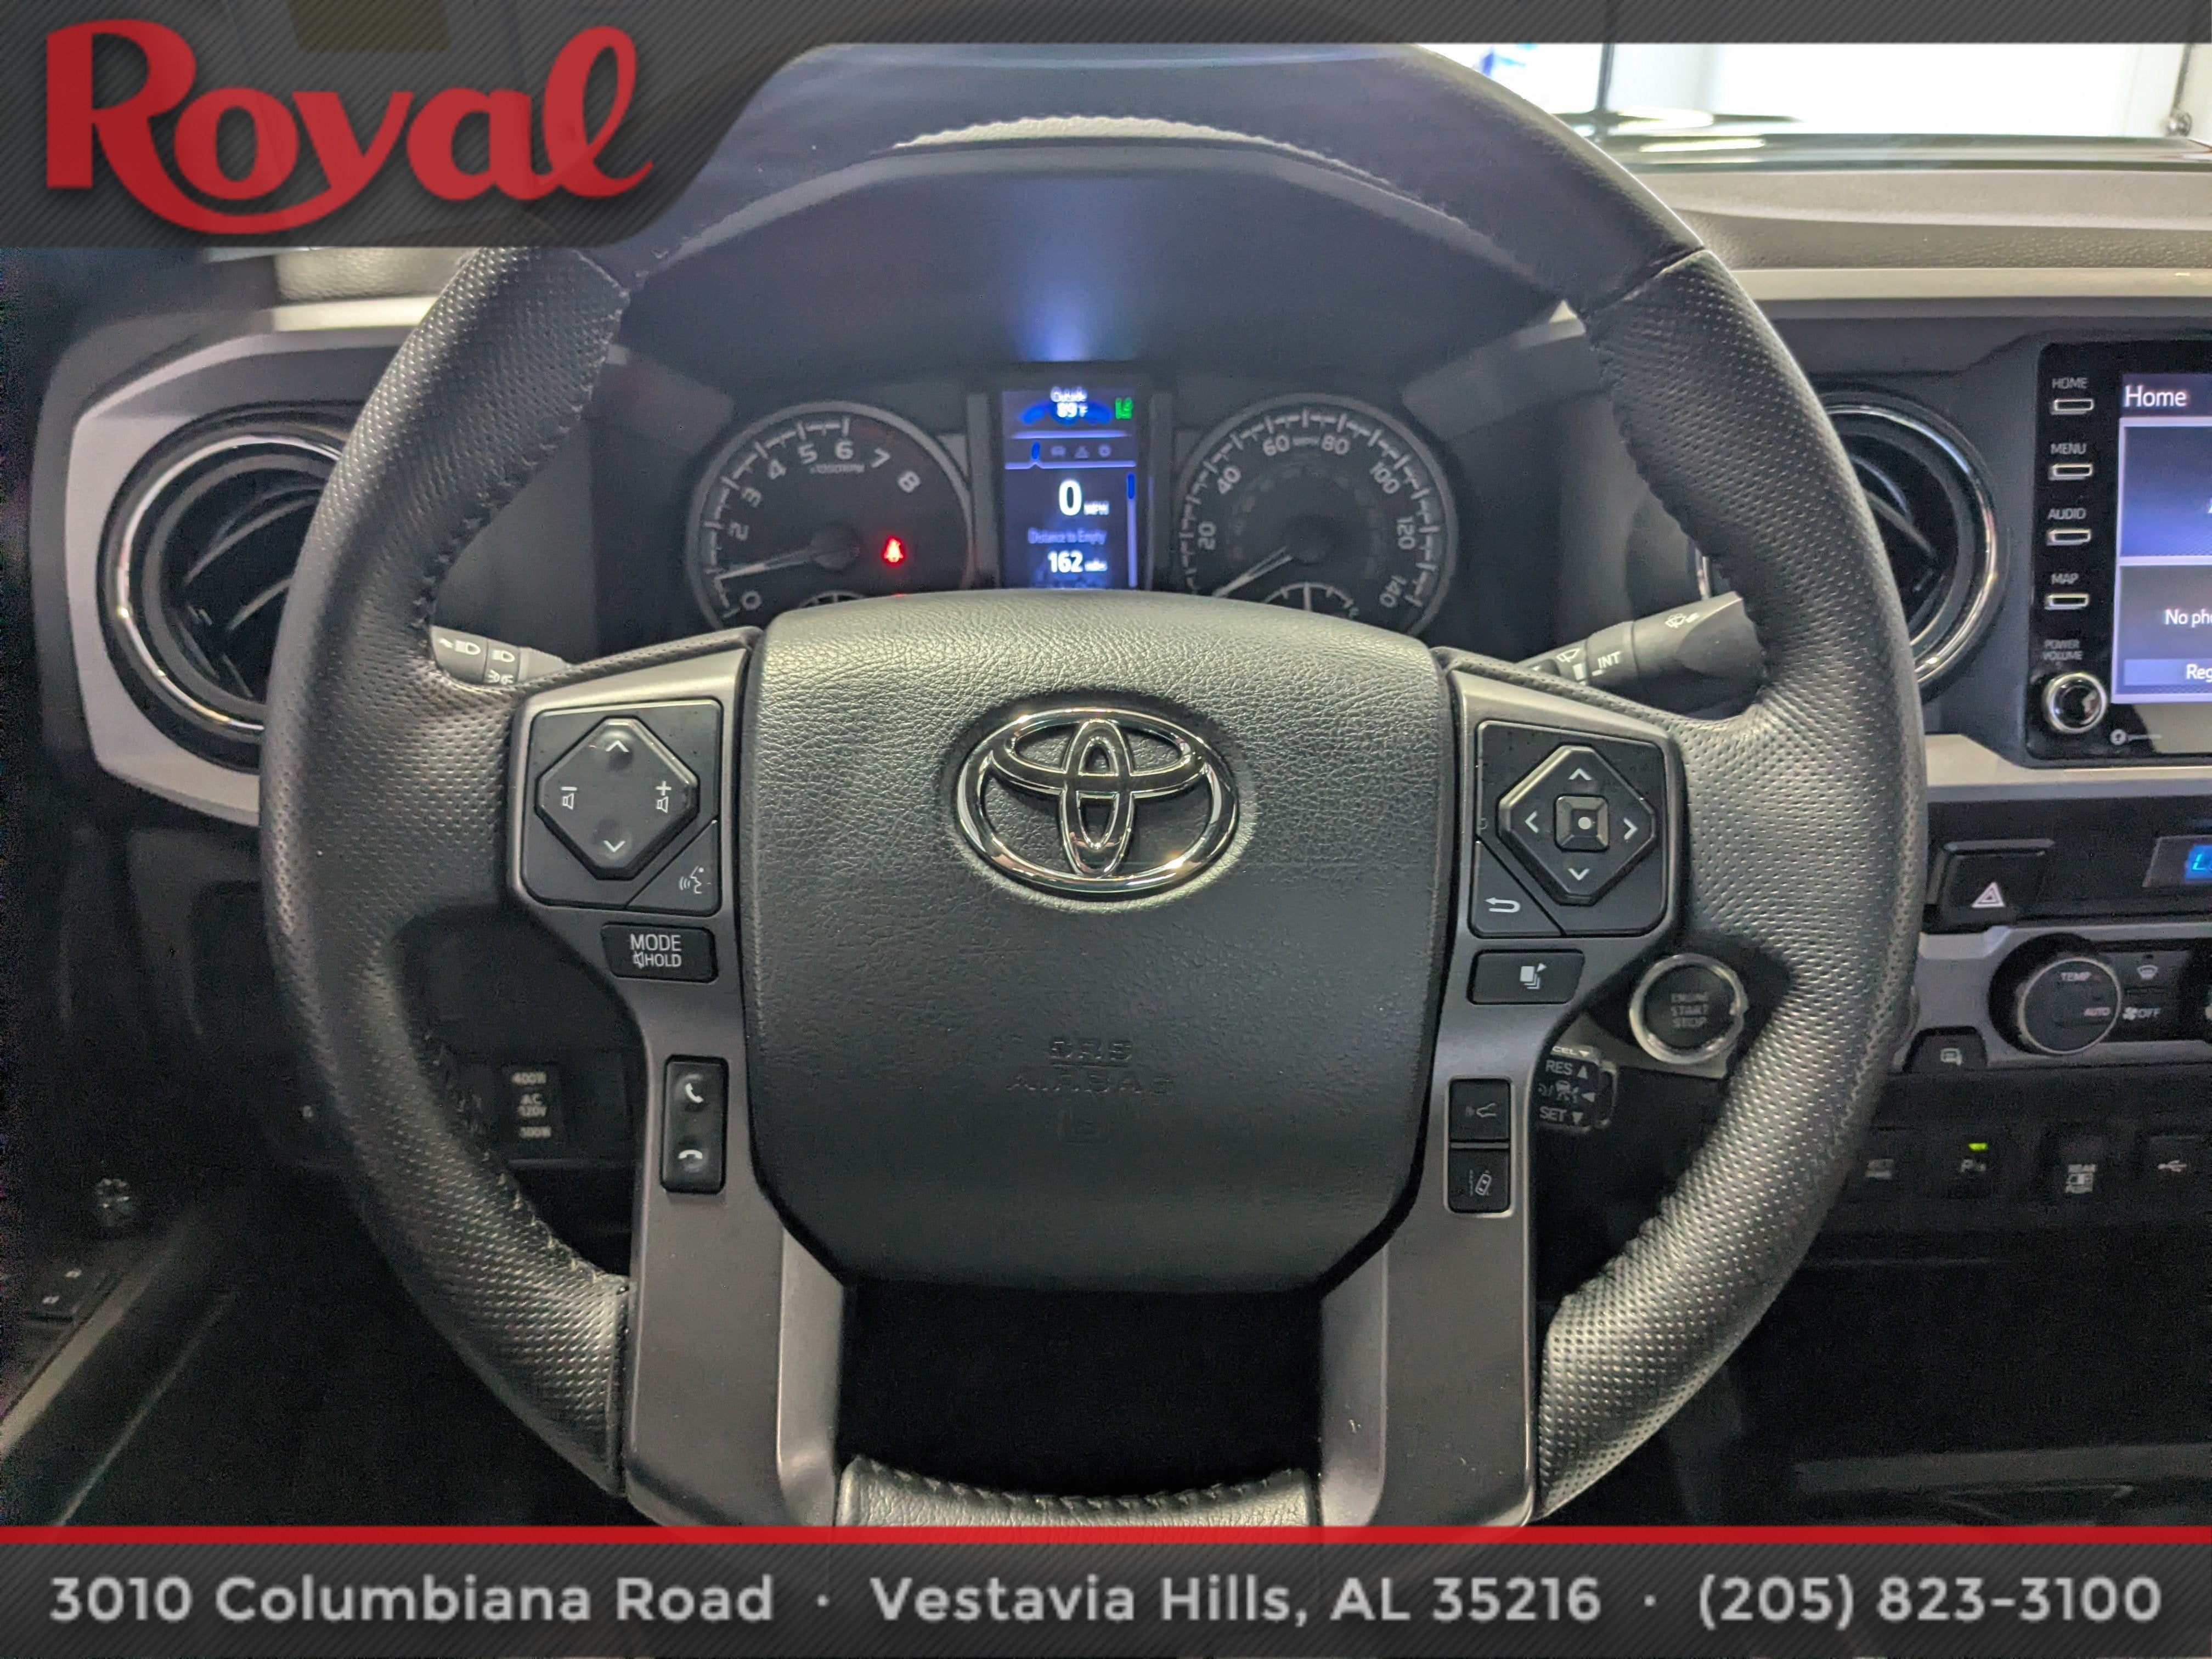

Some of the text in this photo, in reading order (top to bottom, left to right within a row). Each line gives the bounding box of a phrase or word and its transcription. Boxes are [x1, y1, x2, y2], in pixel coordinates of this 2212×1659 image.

[2052, 377, 2087, 390] HOME
[2124, 385, 2188, 408] Home
[799, 444, 819, 465] 5
[836, 440, 854, 460] 6
[1262, 435, 1290, 456] 60
[1321, 435, 1350, 455] 80
[2050, 443, 2087, 455] MENU
[871, 448, 890, 468] 7
[767, 460, 787, 479] 4
[1369, 462, 1400, 494] 100
[897, 471, 921, 494] 8
[1216, 466, 1241, 494] 40
[741, 489, 762, 507] 3
[1059, 479, 1082, 516] 0
[2047, 508, 2086, 520] AUDIO
[727, 522, 748, 541] 2
[1198, 521, 1216, 550] 20
[1396, 517, 1415, 549] 120
[1048, 550, 1083, 573] 162
[2051, 573, 2079, 585] MAP
[741, 591, 762, 610] 0
[1379, 574, 1407, 608] 140
[2165, 608, 2212, 628] No ph
[1598, 651, 1622, 669] INT
[630, 934, 682, 952] MODE
[645, 952, 682, 967] HOLD
[2061, 972, 2091, 981] TEMP
[2084, 1007, 2111, 1017] AUTO
[1545, 1059, 1573, 1075] RES
[1539, 1105, 1567, 1122] SET
